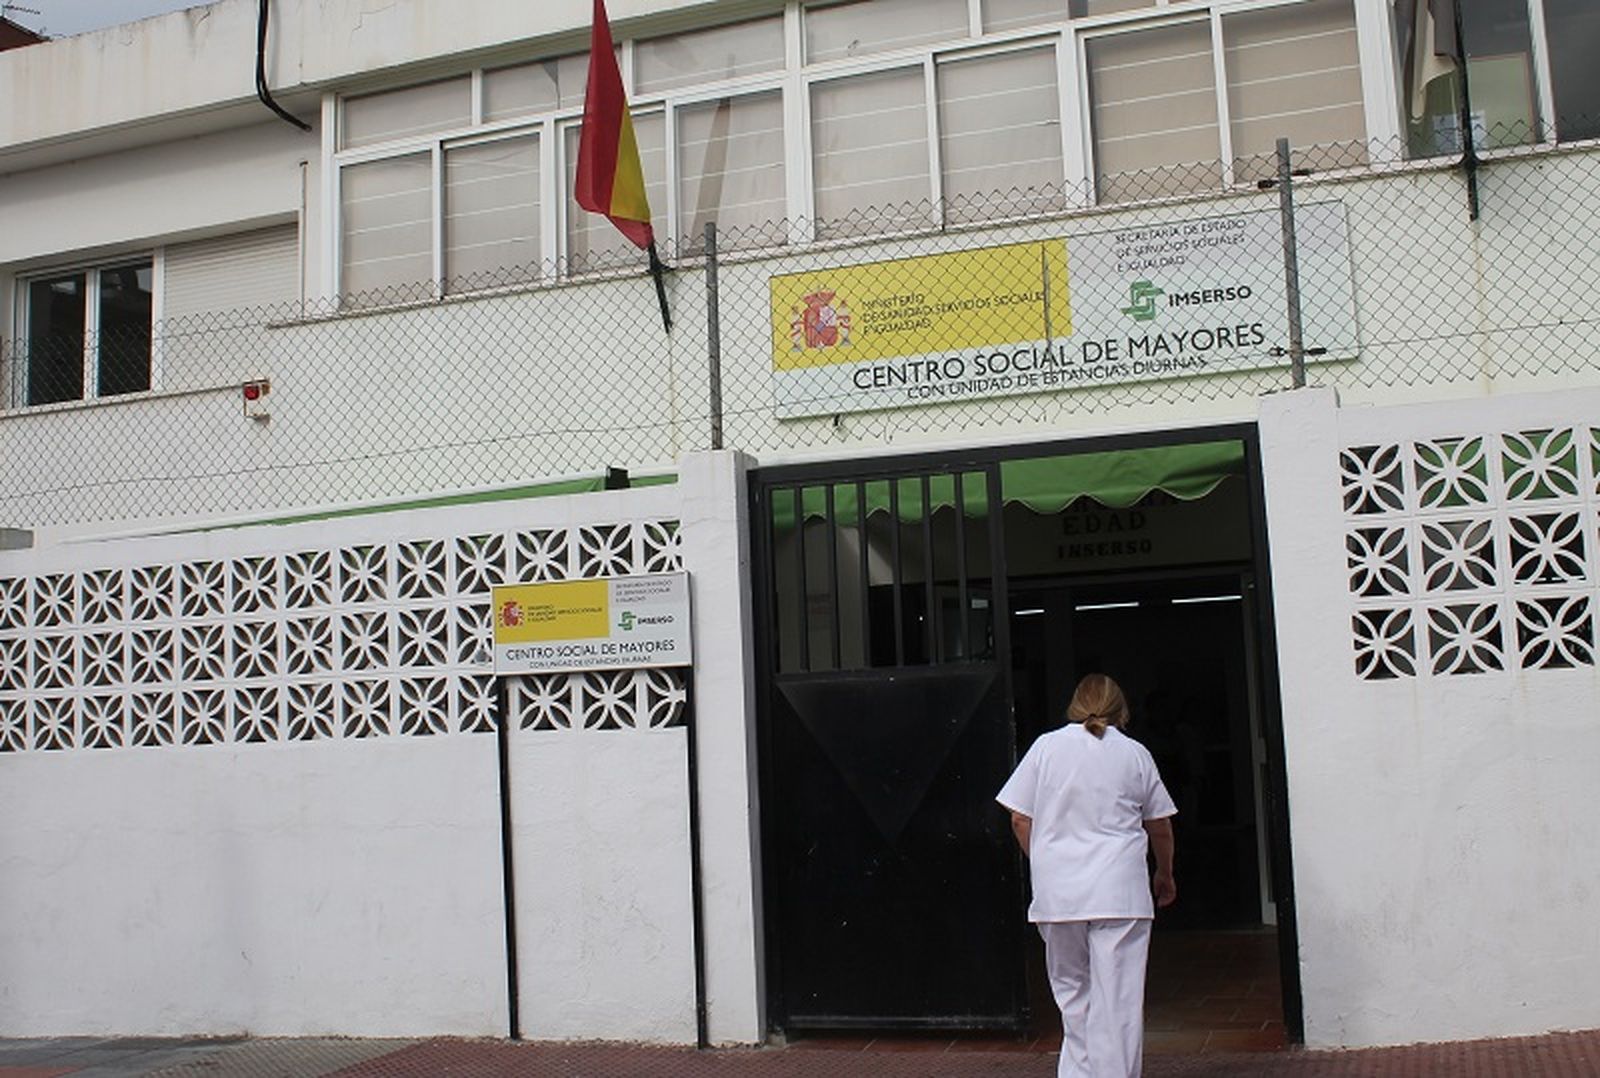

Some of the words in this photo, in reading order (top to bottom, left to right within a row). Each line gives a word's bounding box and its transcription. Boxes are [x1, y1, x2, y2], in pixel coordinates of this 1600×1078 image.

[1184, 224, 1198, 236] DE
[1201, 218, 1246, 234] ESTADO
[1117, 246, 1130, 260] DE
[1133, 240, 1189, 257] SERVICIOS
[1191, 233, 1246, 249] SOCIALES
[1168, 285, 1252, 308] IMSERSO
[853, 357, 966, 391] CENTRO
[974, 347, 1073, 378] SOCIAL
[1082, 338, 1120, 363] DE
[1127, 322, 1266, 358] MAYORES
[907, 384, 945, 400] CON
[948, 376, 1014, 396] UNIDAD
[1017, 372, 1039, 388] DE
[1042, 362, 1130, 386] ESTANCIAS
[1132, 353, 1208, 377] DIURNAS
[1063, 511, 1146, 536] EDAD
[1058, 538, 1153, 560] INSERSO
[506, 647, 554, 661] CENTRO
[557, 645, 598, 658] SOCIAL
[601, 643, 617, 655] DE
[619, 639, 675, 653] MAYORES
